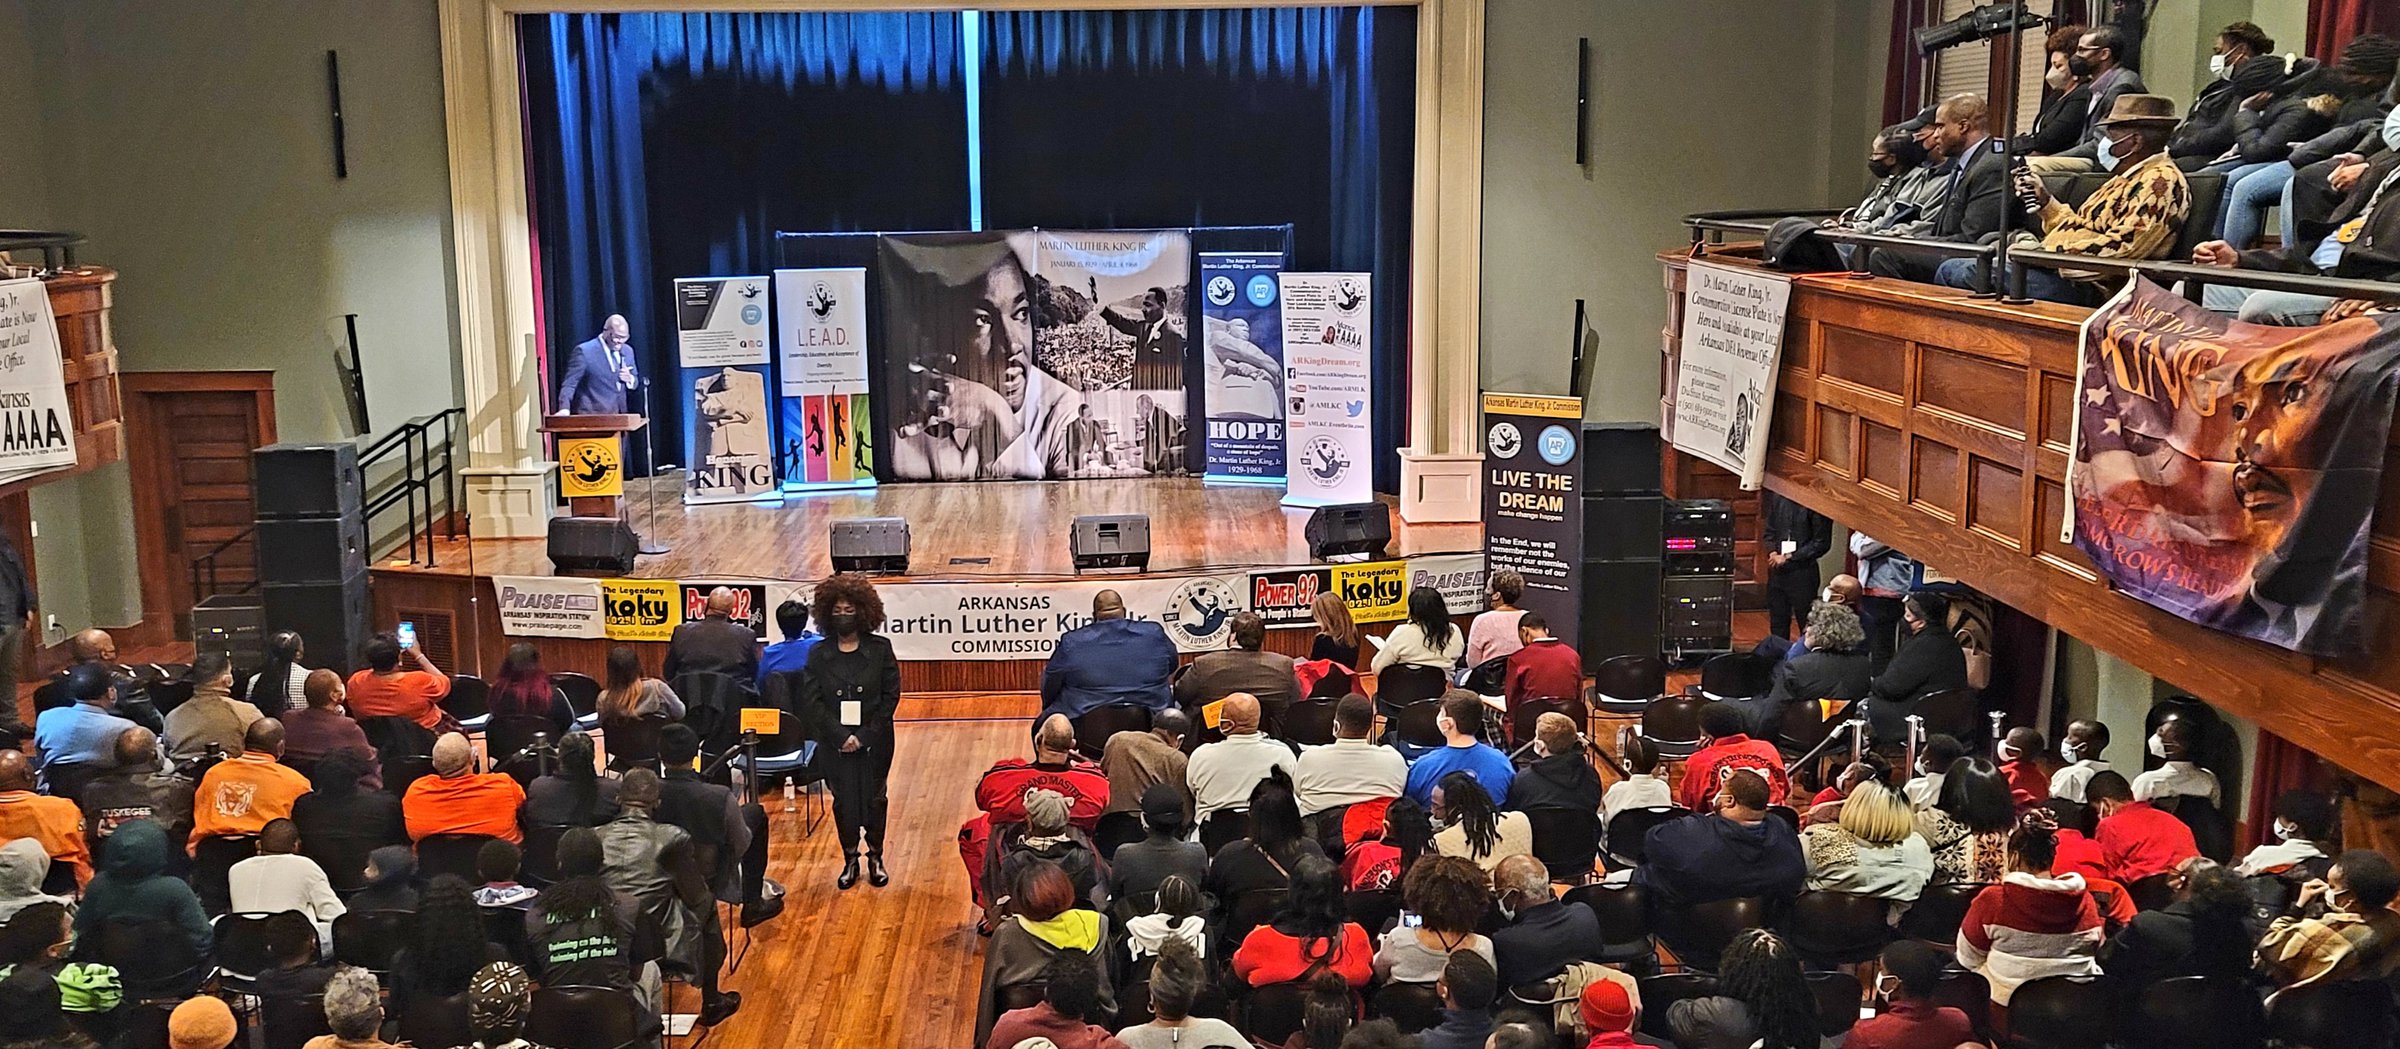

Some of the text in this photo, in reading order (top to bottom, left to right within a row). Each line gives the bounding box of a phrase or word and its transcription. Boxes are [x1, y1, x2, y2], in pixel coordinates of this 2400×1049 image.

[1040, 241, 1073, 250] MARTIN
[1076, 242, 1110, 251] LUTHER
[1113, 242, 1136, 251] KING
[14, 313, 20, 326] is
[1697, 311, 1711, 327] Here
[798, 328, 849, 346] L.E.A.D.
[1486, 397, 1505, 407] Arkansas
[1506, 399, 1519, 408] Martin
[1520, 399, 1533, 408] Luther
[1553, 401, 1580, 411] Commission
[1209, 422, 1282, 440] HOPE
[1259, 458, 1274, 466] King,
[1229, 466, 1262, 474] 1929-1968
[694, 464, 771, 489] KING
[1492, 469, 1572, 491] LIVE THE
[1500, 491, 1563, 513] DREAM
[1516, 511, 1538, 520] change
[1540, 513, 1563, 521] happen
[1513, 538, 1529, 547] End,
[1491, 546, 1528, 555] remember
[1542, 550, 1555, 558] the
[1517, 566, 1543, 574] silence
[1544, 568, 1553, 576] of
[1537, 560, 1570, 570] enemies,
[1358, 568, 1399, 578] Legendary
[1411, 570, 1474, 592] PRAISE
[620, 587, 664, 596] Legendary
[1255, 573, 1318, 607] POWER 92
[1342, 576, 1402, 604] koky
[1443, 590, 1474, 598] INSPIRATION
[500, 586, 565, 609] PRAISE
[958, 596, 1050, 610] ARKANSAS
[1348, 598, 1390, 609] 02.1 fm
[604, 594, 668, 624] koky
[534, 612, 567, 620] INSPIRATION
[606, 616, 658, 625] 102.1 fm
[512, 622, 583, 630] www.praisepage.com
[962, 614, 1047, 633] Luther
[1056, 612, 1094, 632] Kin
[1173, 622, 1191, 642] MARTIN
[1016, 776, 1047, 797] GRAND
[102, 807, 151, 817] TUSKEGEE
[590, 937, 601, 945] the
[579, 950, 589, 958] off
[590, 949, 602, 957] the
[603, 948, 617, 956] field
